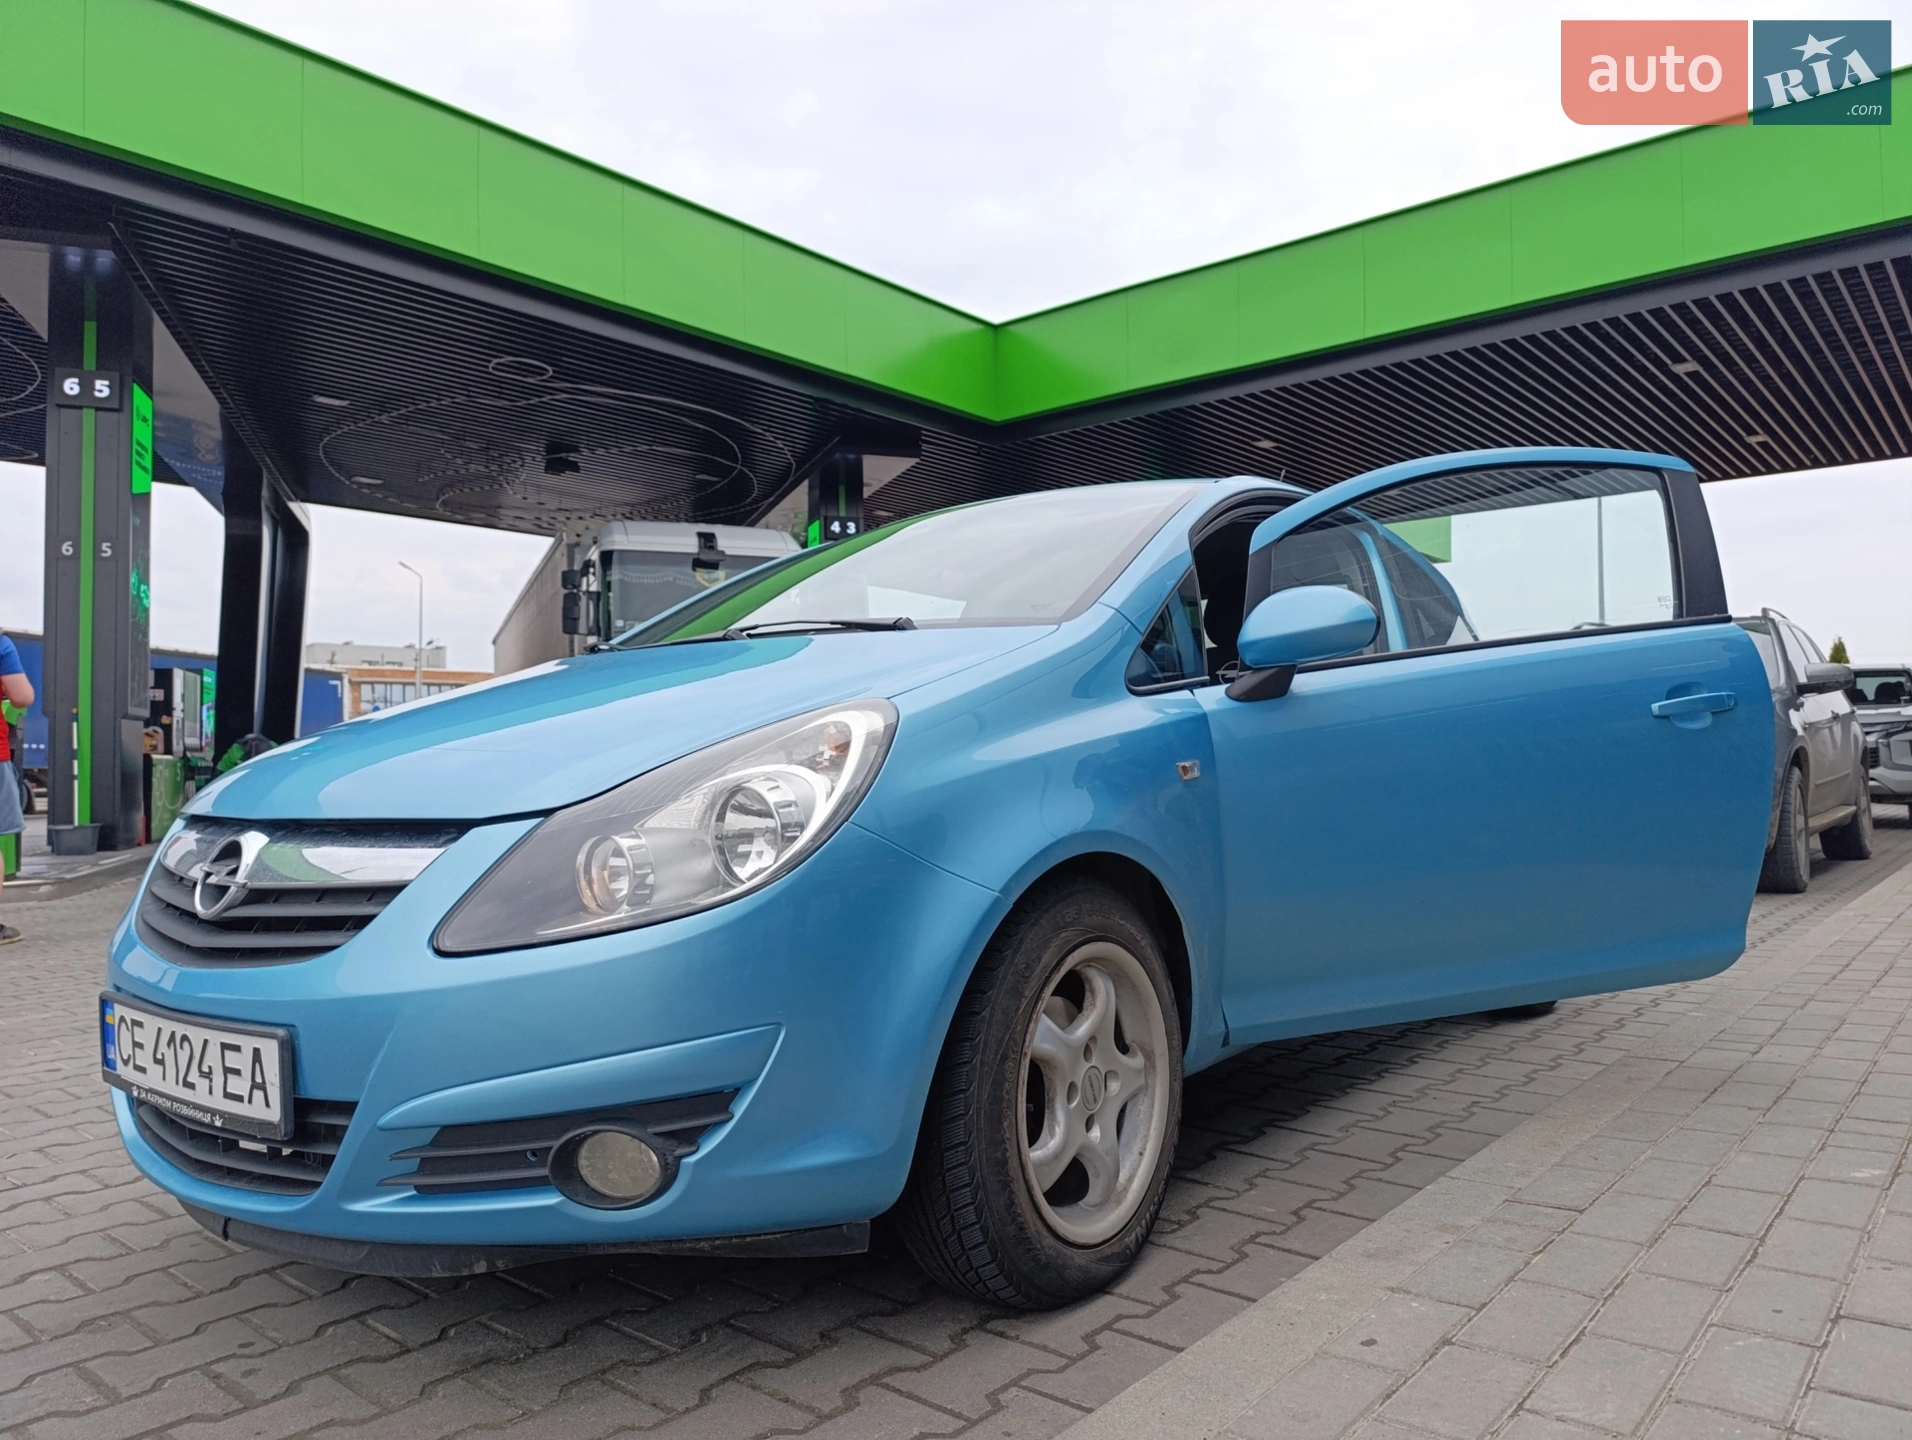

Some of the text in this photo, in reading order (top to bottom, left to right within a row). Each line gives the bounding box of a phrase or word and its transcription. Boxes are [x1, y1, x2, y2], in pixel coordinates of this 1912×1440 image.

[63, 377, 110, 398] 6 5
[830, 521, 856, 534] 4 3
[61, 541, 112, 557] 6 5
[106, 1043, 116, 1061] UA
[117, 1014, 270, 1108] CE 4124 EA
[139, 1088, 147, 1099] ЗА
[147, 1091, 172, 1110] КЕРМОМ
